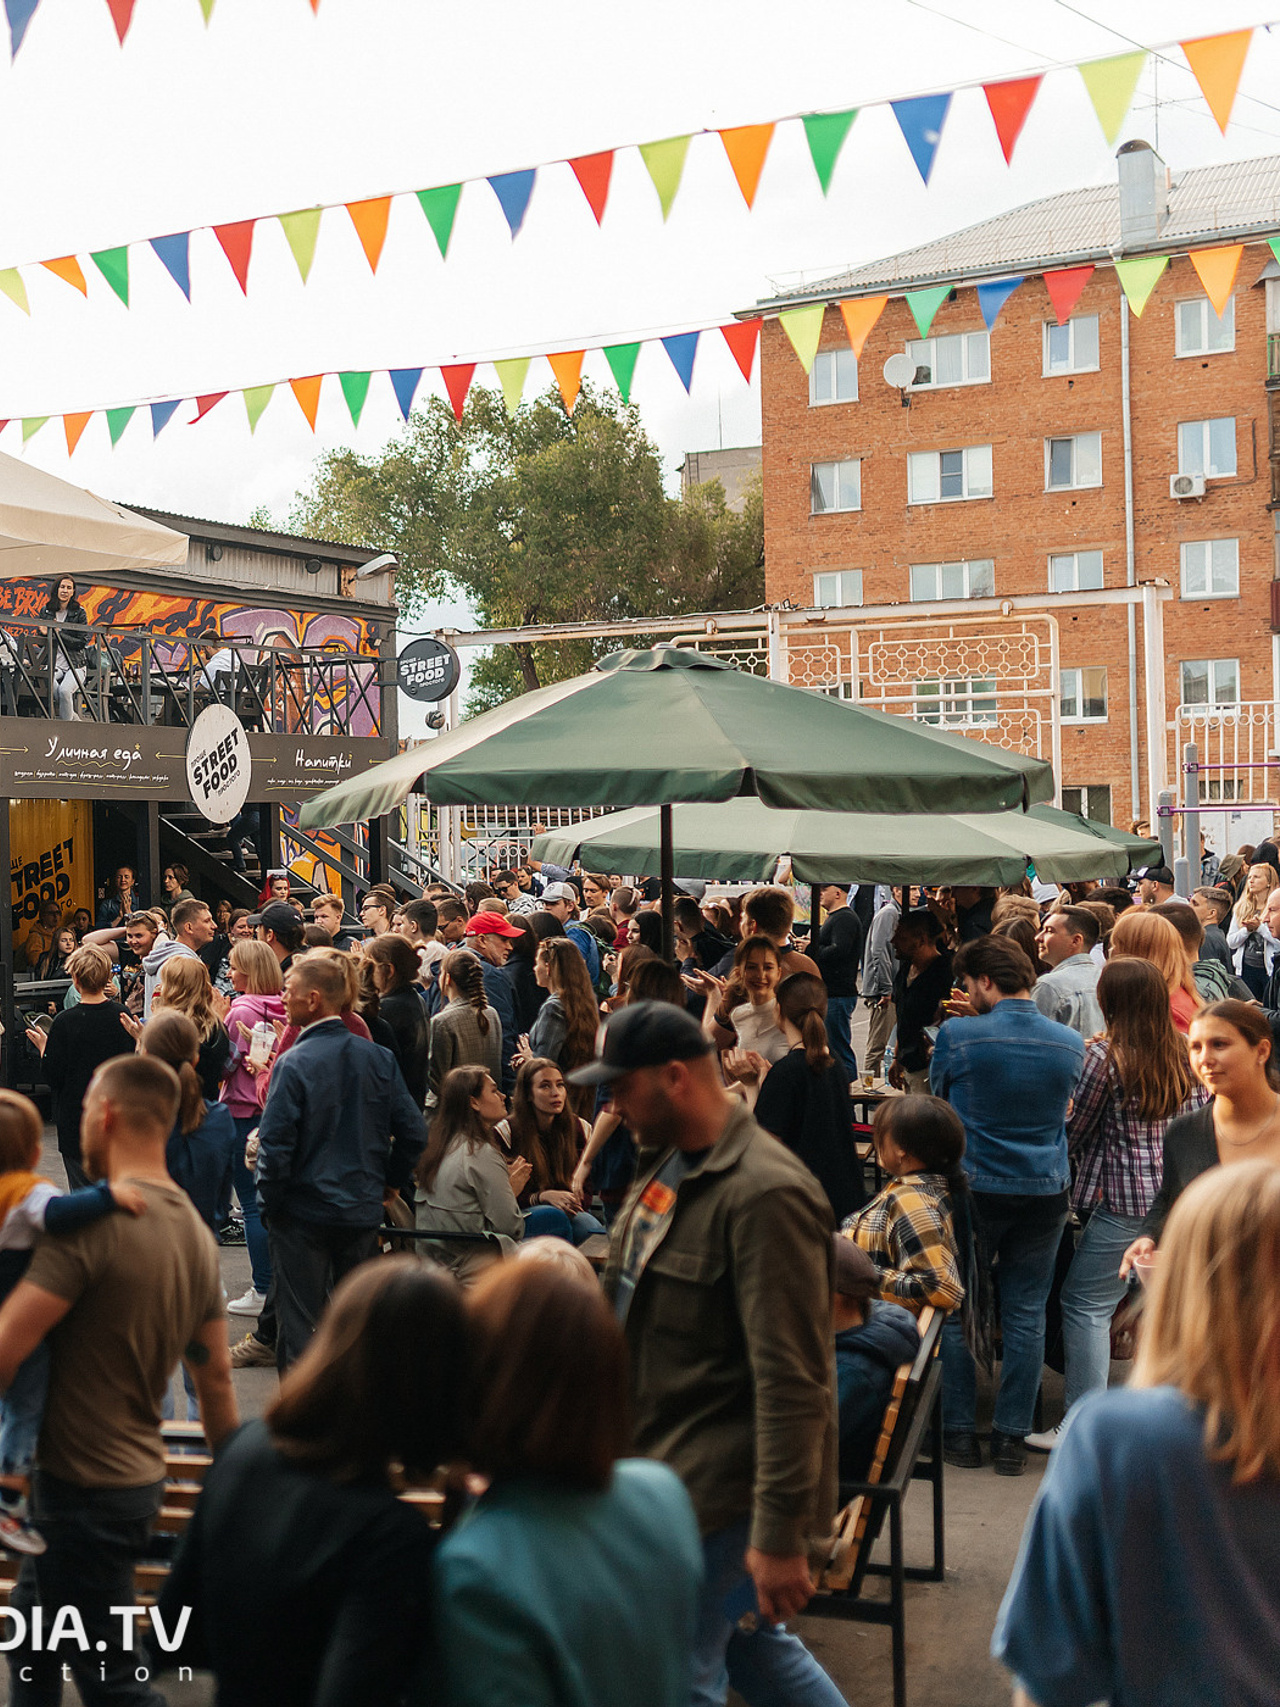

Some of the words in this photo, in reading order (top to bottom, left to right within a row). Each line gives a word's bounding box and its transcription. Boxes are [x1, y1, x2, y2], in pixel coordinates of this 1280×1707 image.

[12, 586, 50, 618] BRYA
[400, 653, 451, 676] STREET
[406, 667, 445, 686] FOOD
[44, 736, 108, 761] Уличная
[113, 748, 142, 771] еда
[193, 726, 239, 786] STREET
[295, 748, 352, 775] Напитки
[203, 753, 237, 800] FOOD
[11, 837, 74, 898] TREET
[11, 873, 70, 931] FOOD
